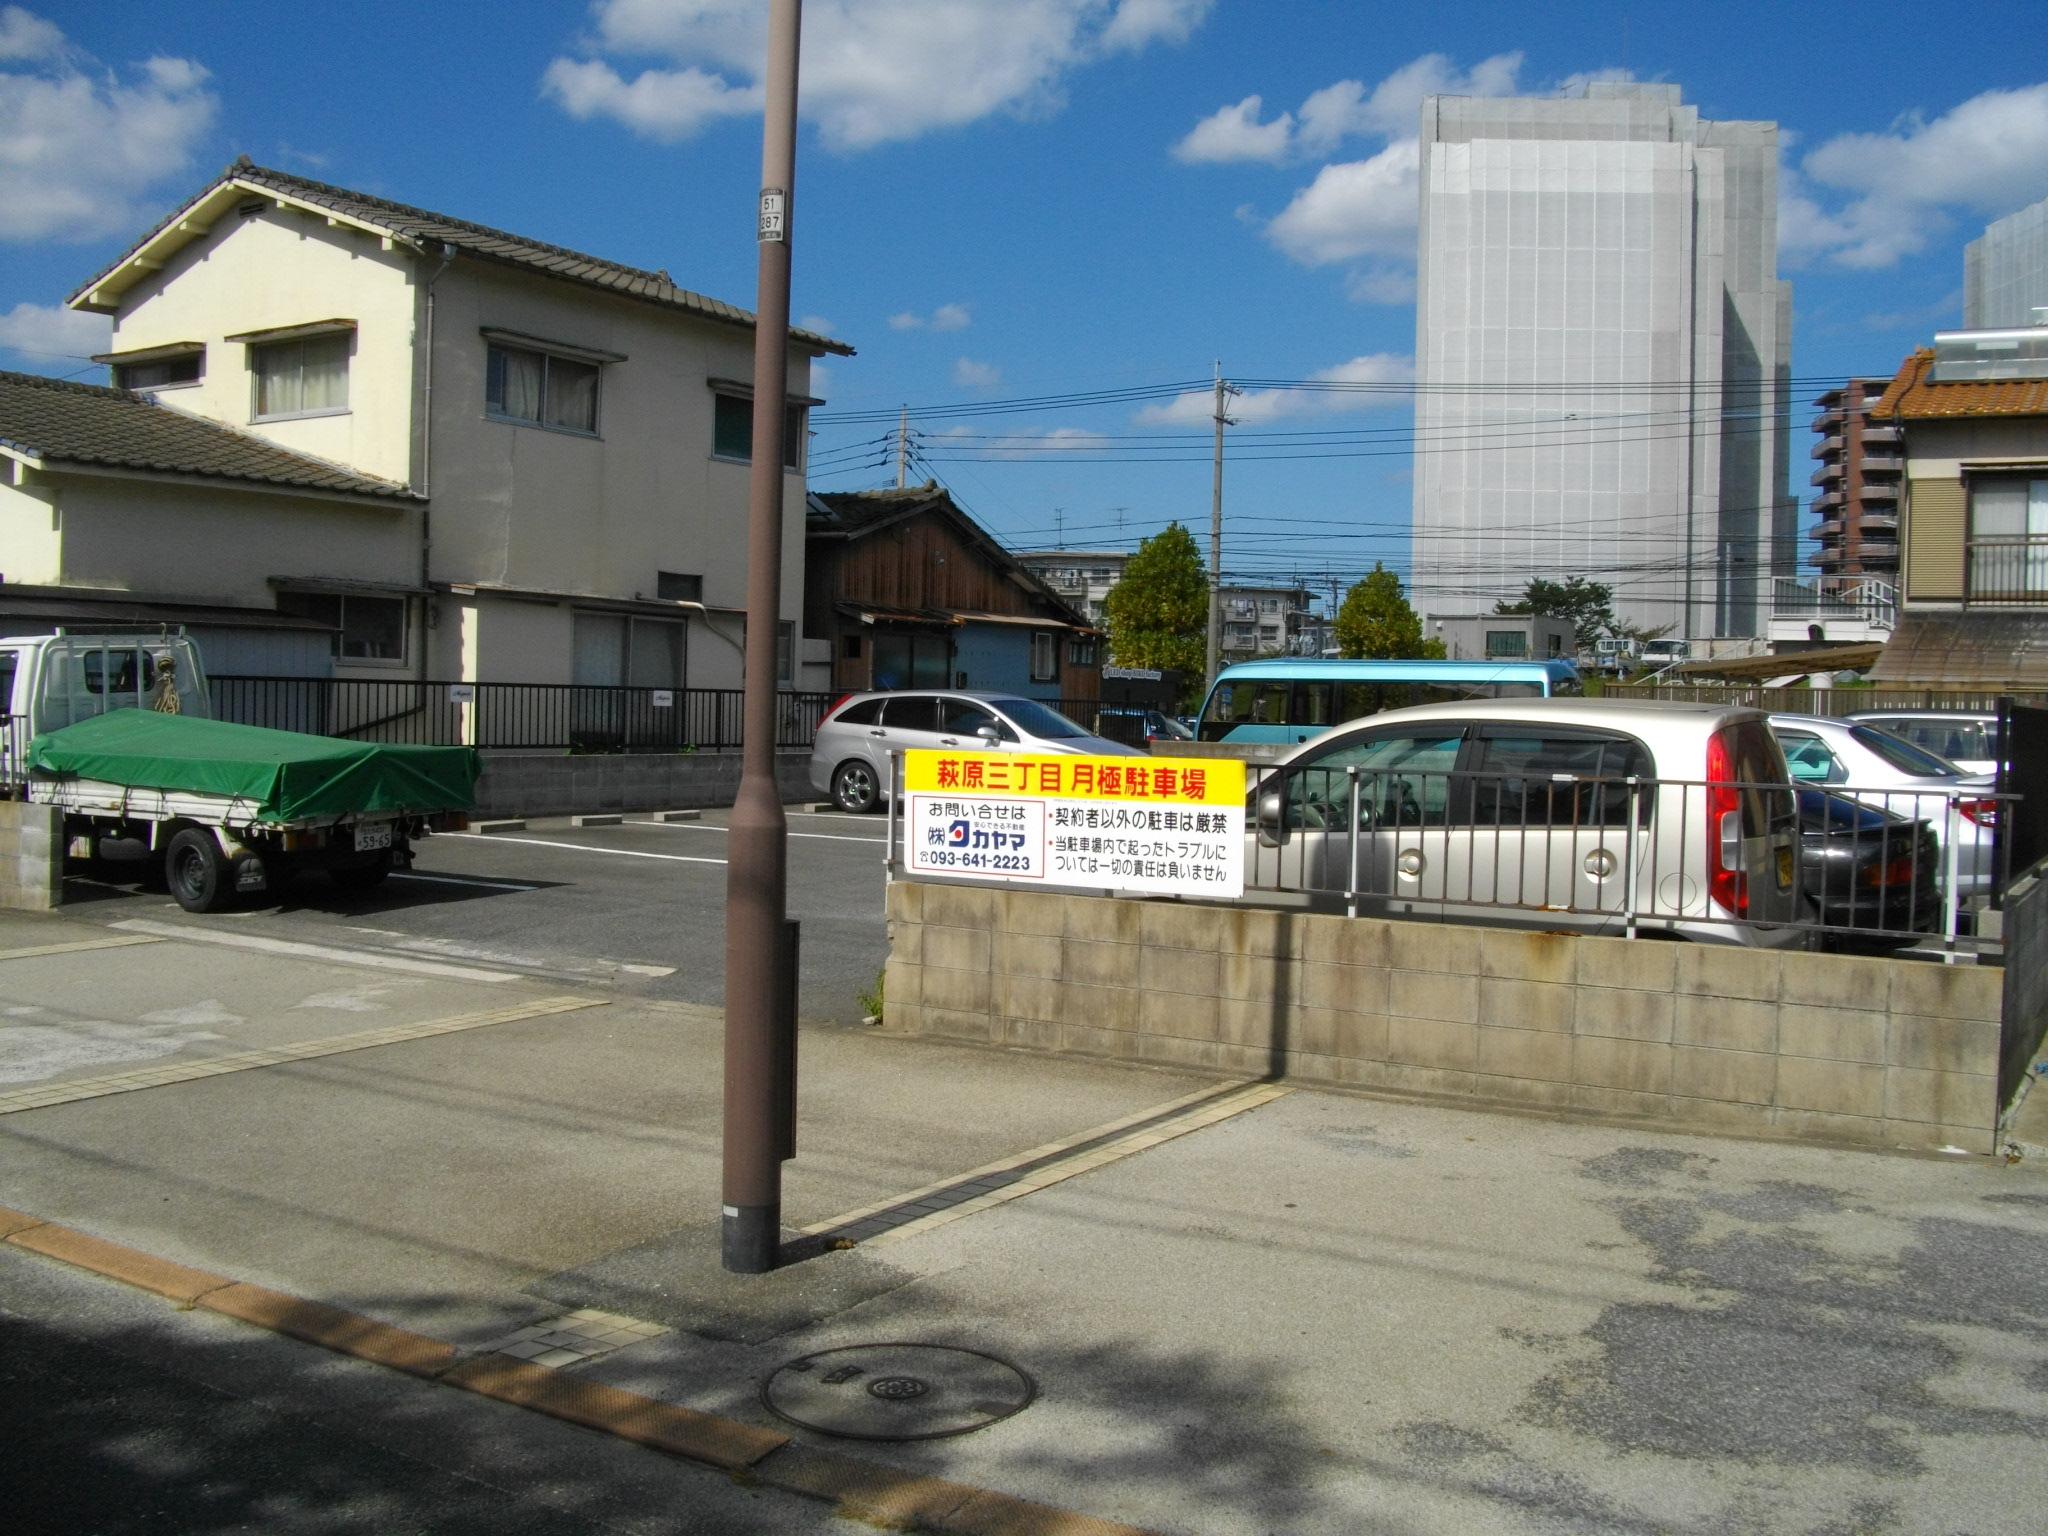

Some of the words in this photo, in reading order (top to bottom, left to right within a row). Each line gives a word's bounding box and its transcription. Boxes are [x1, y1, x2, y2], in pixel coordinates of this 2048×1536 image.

[764, 198, 774, 210] 51
[761, 216, 779, 230] 287
[937, 760, 1061, 792] 萩原三丁目
[1071, 764, 1207, 800] 月極駐車場
[929, 802, 1026, 820] お問い合せは
[1055, 807, 1228, 834] 契約者以外の駐車は厳禁
[363, 834, 390, 848] 59-65
[1055, 835, 1227, 861] 当駐車場内で起ったトラブルに
[930, 851, 1031, 871] 093-641-2223
[1055, 855, 1227, 882] ついては一切の責任は負いません
